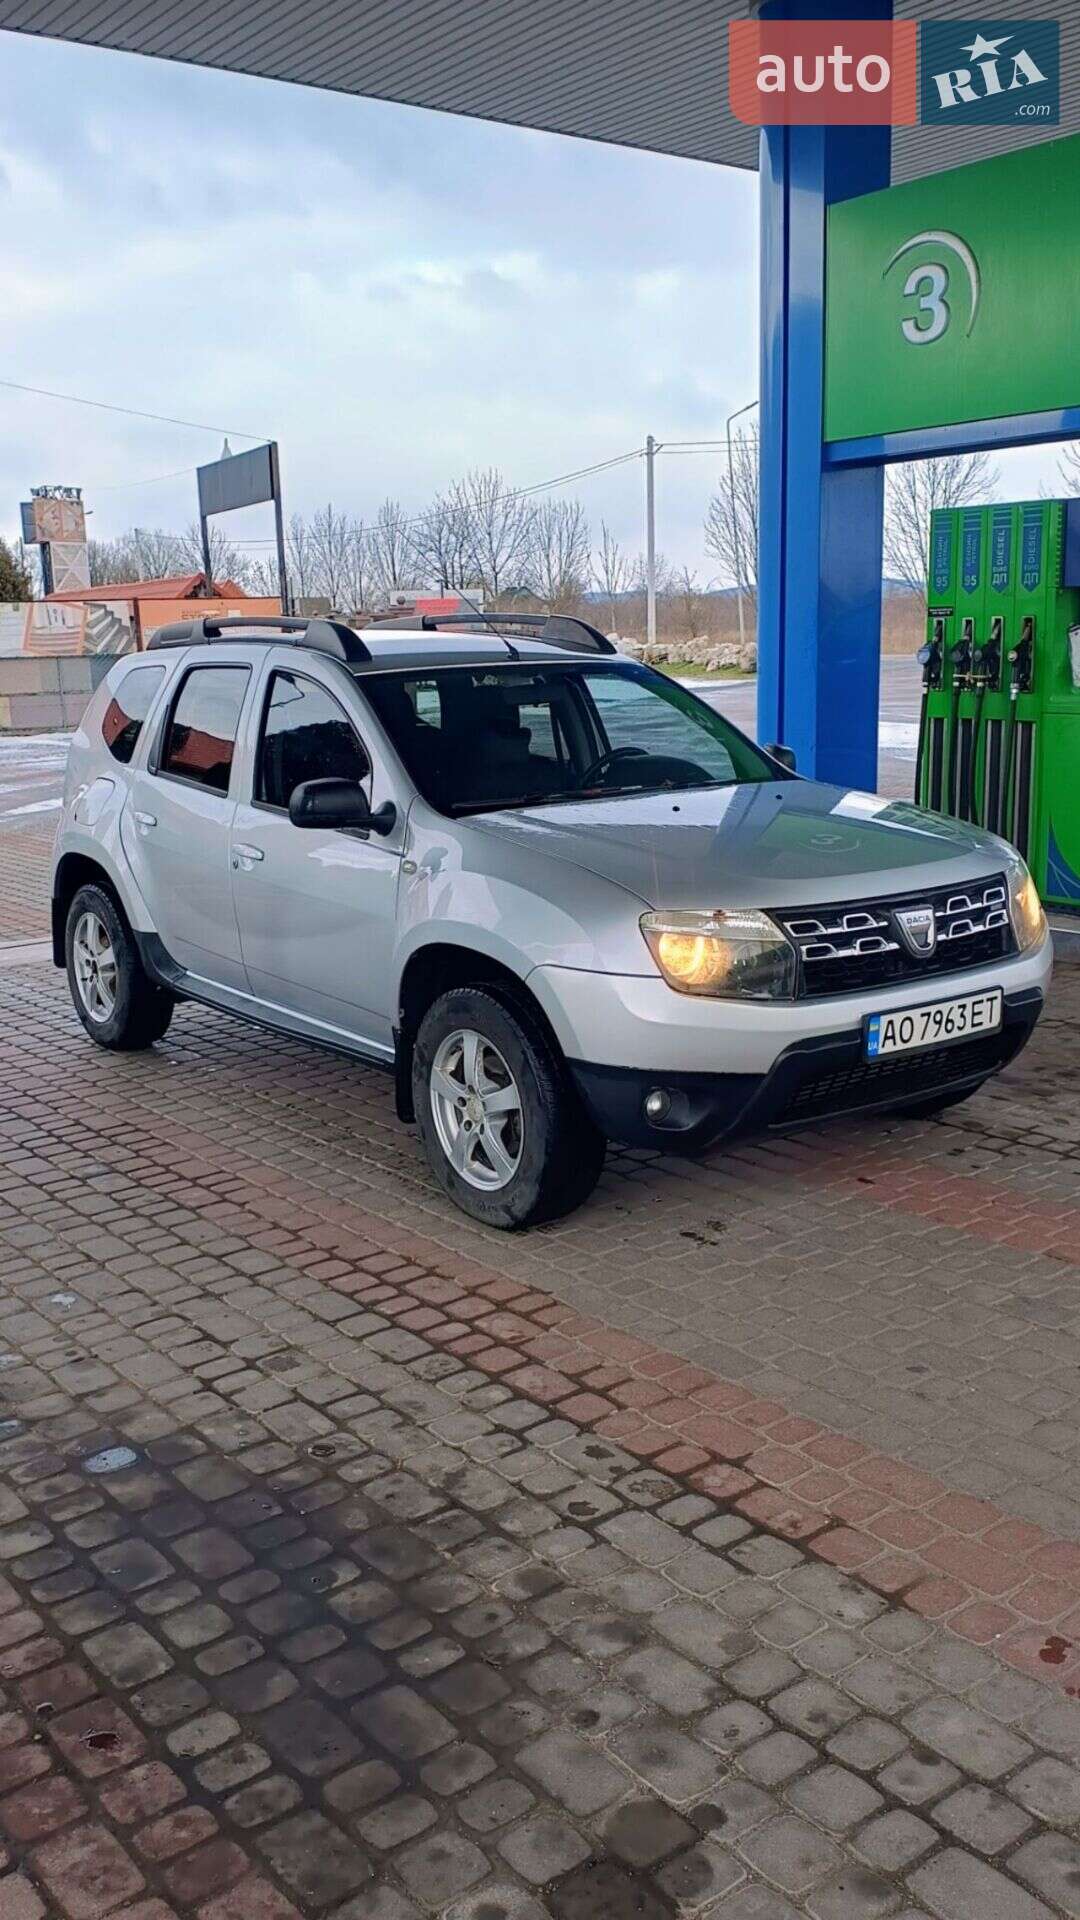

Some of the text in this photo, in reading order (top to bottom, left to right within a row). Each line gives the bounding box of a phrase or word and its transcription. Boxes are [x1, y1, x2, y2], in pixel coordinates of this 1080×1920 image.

[901, 262, 950, 345] 3
[997, 530, 1005, 565] DIESEL
[1028, 527, 1037, 564] DIESEL
[935, 576, 948, 588] 95
[963, 575, 977, 587] 95
[991, 573, 1007, 585] ДП
[1023, 572, 1039, 585] ДП
[906, 915, 931, 925] DACIA
